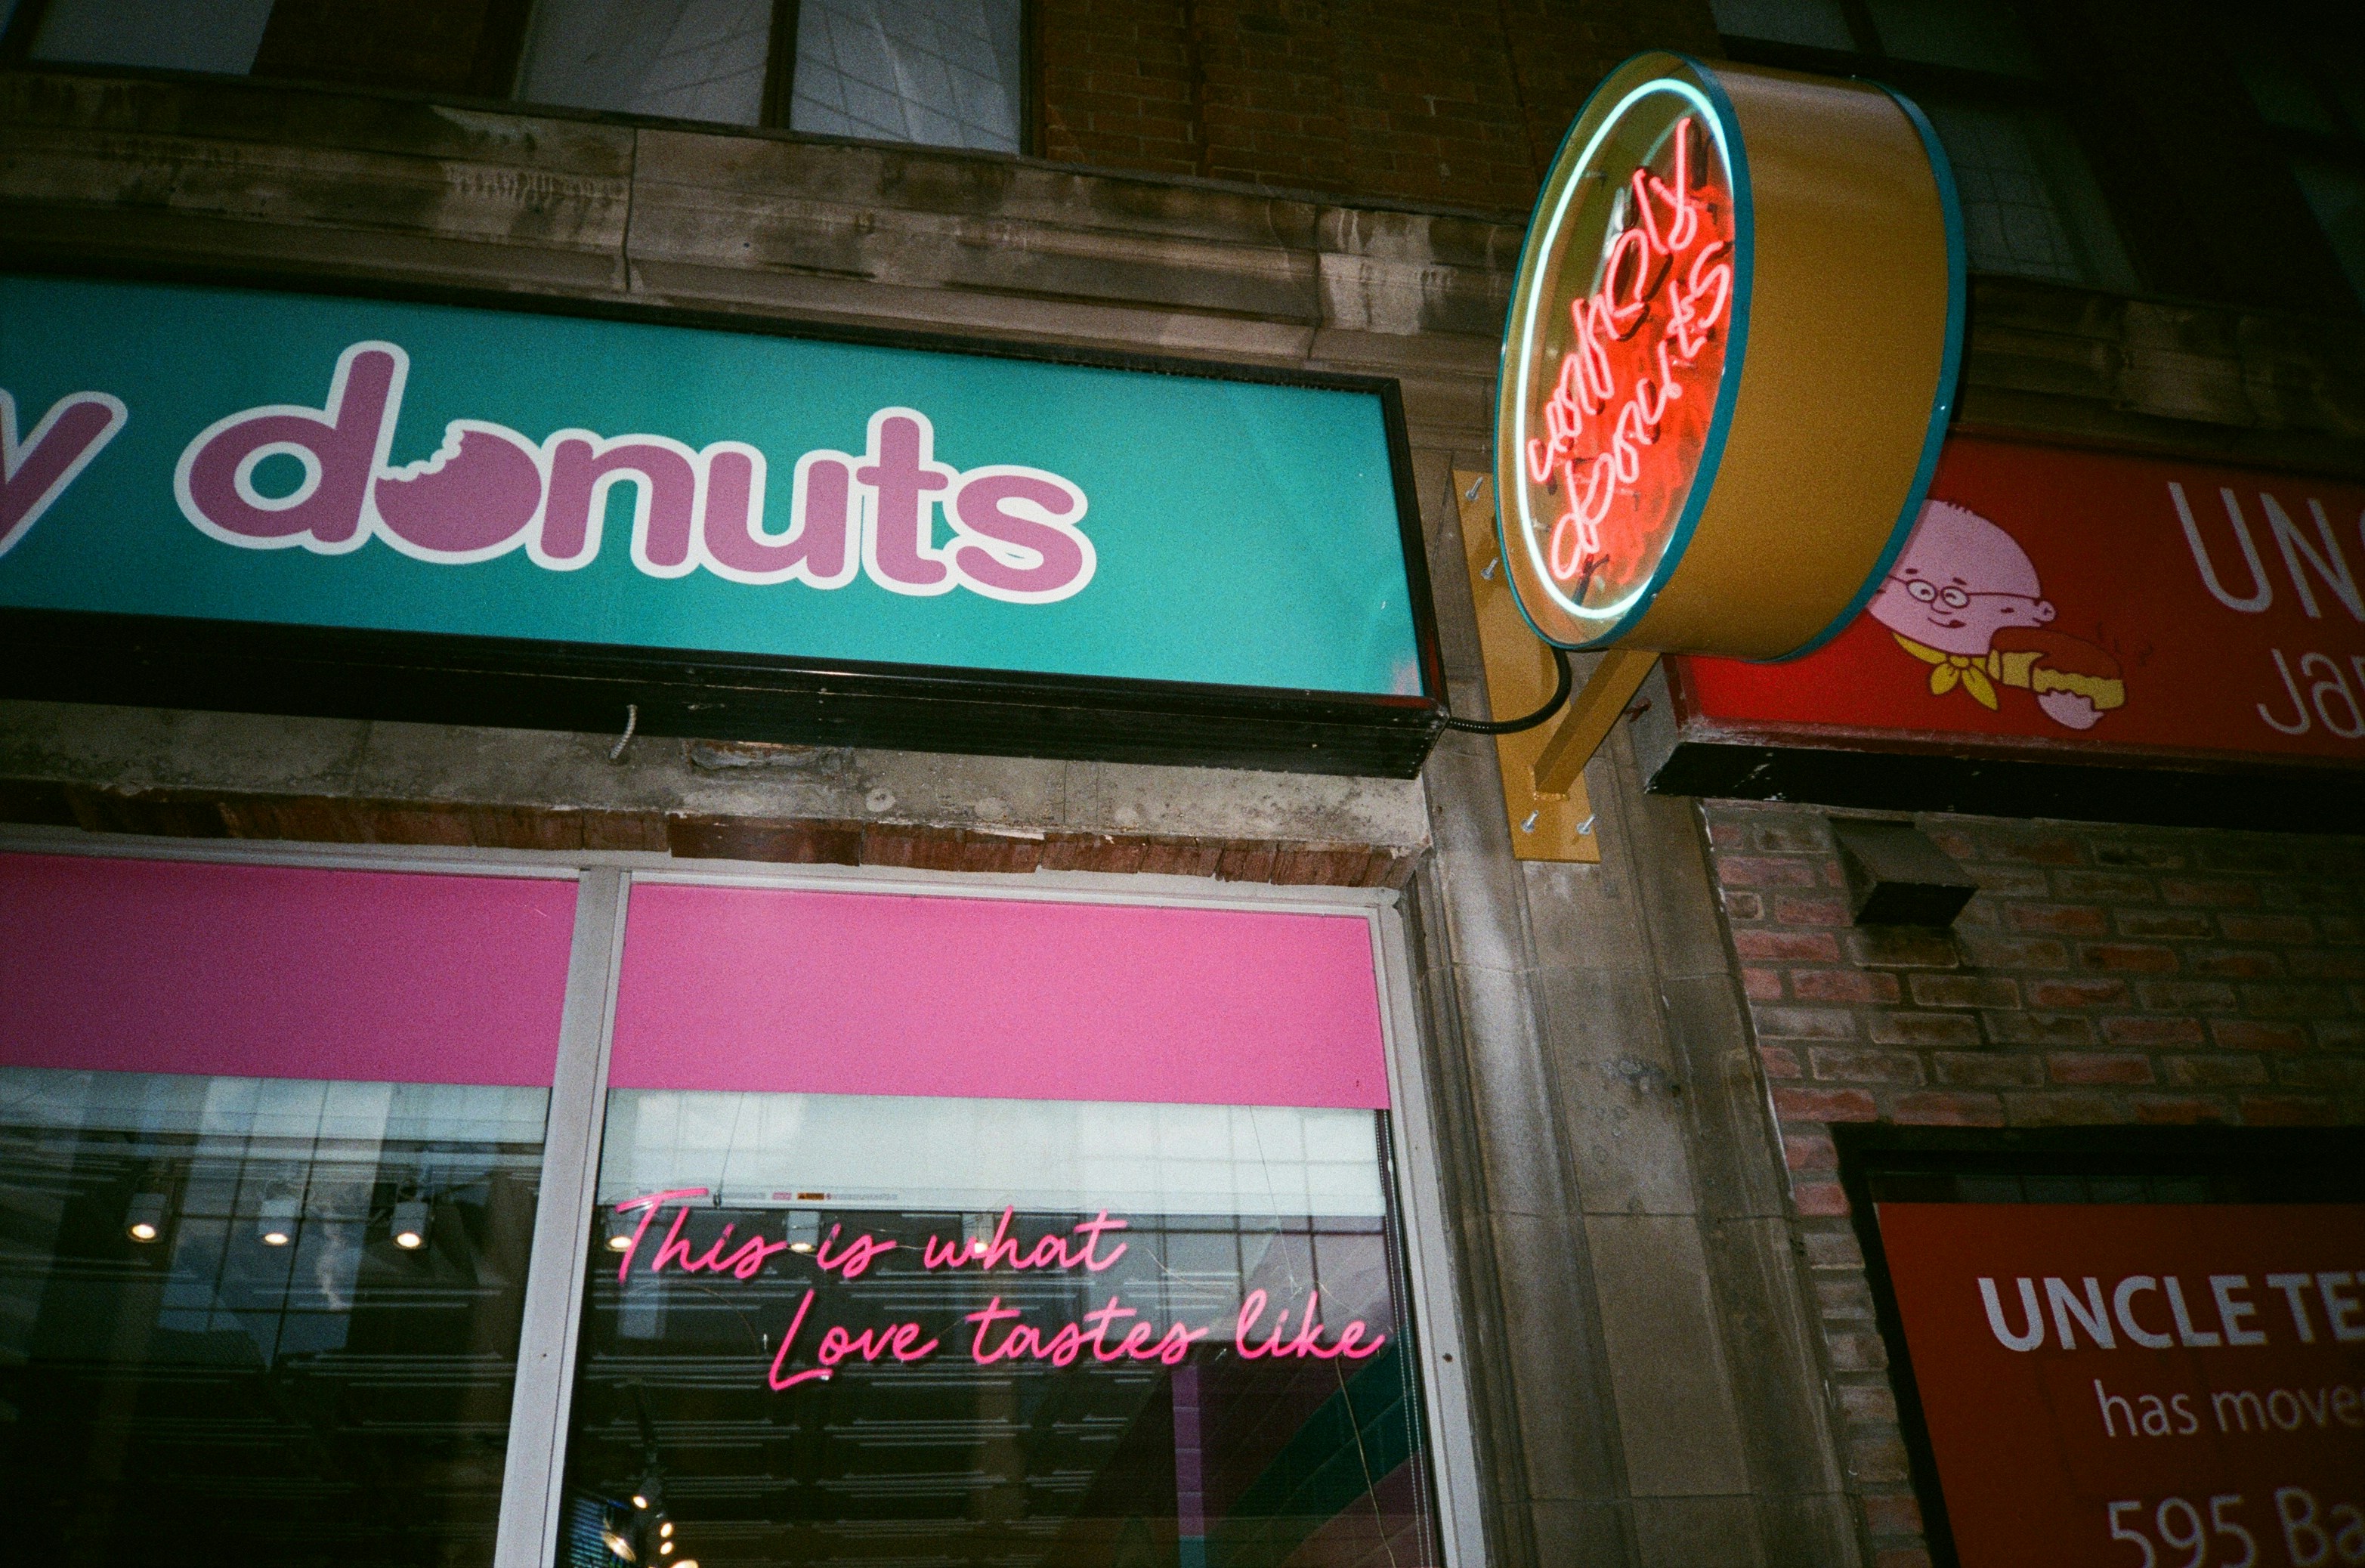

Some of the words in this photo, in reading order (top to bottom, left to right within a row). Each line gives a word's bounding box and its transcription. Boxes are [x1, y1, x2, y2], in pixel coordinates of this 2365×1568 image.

[1551, 240, 1731, 580] donuts
[174, 340, 1096, 604] donuts
[2166, 481, 2365, 623] UN
[615, 1187, 787, 1285] This
[817, 1223, 897, 1279] is
[923, 1205, 1128, 1272] what
[768, 1288, 939, 1390] Love
[965, 1296, 1209, 1367] tastes
[1235, 1288, 1387, 1359] like
[1977, 1274, 2268, 1352] UNCLE
[2266, 1270, 2365, 1344] TE
[2094, 1378, 2199, 1437] has
[2211, 1384, 2365, 1432] move
[2107, 1493, 2257, 1568] 595
